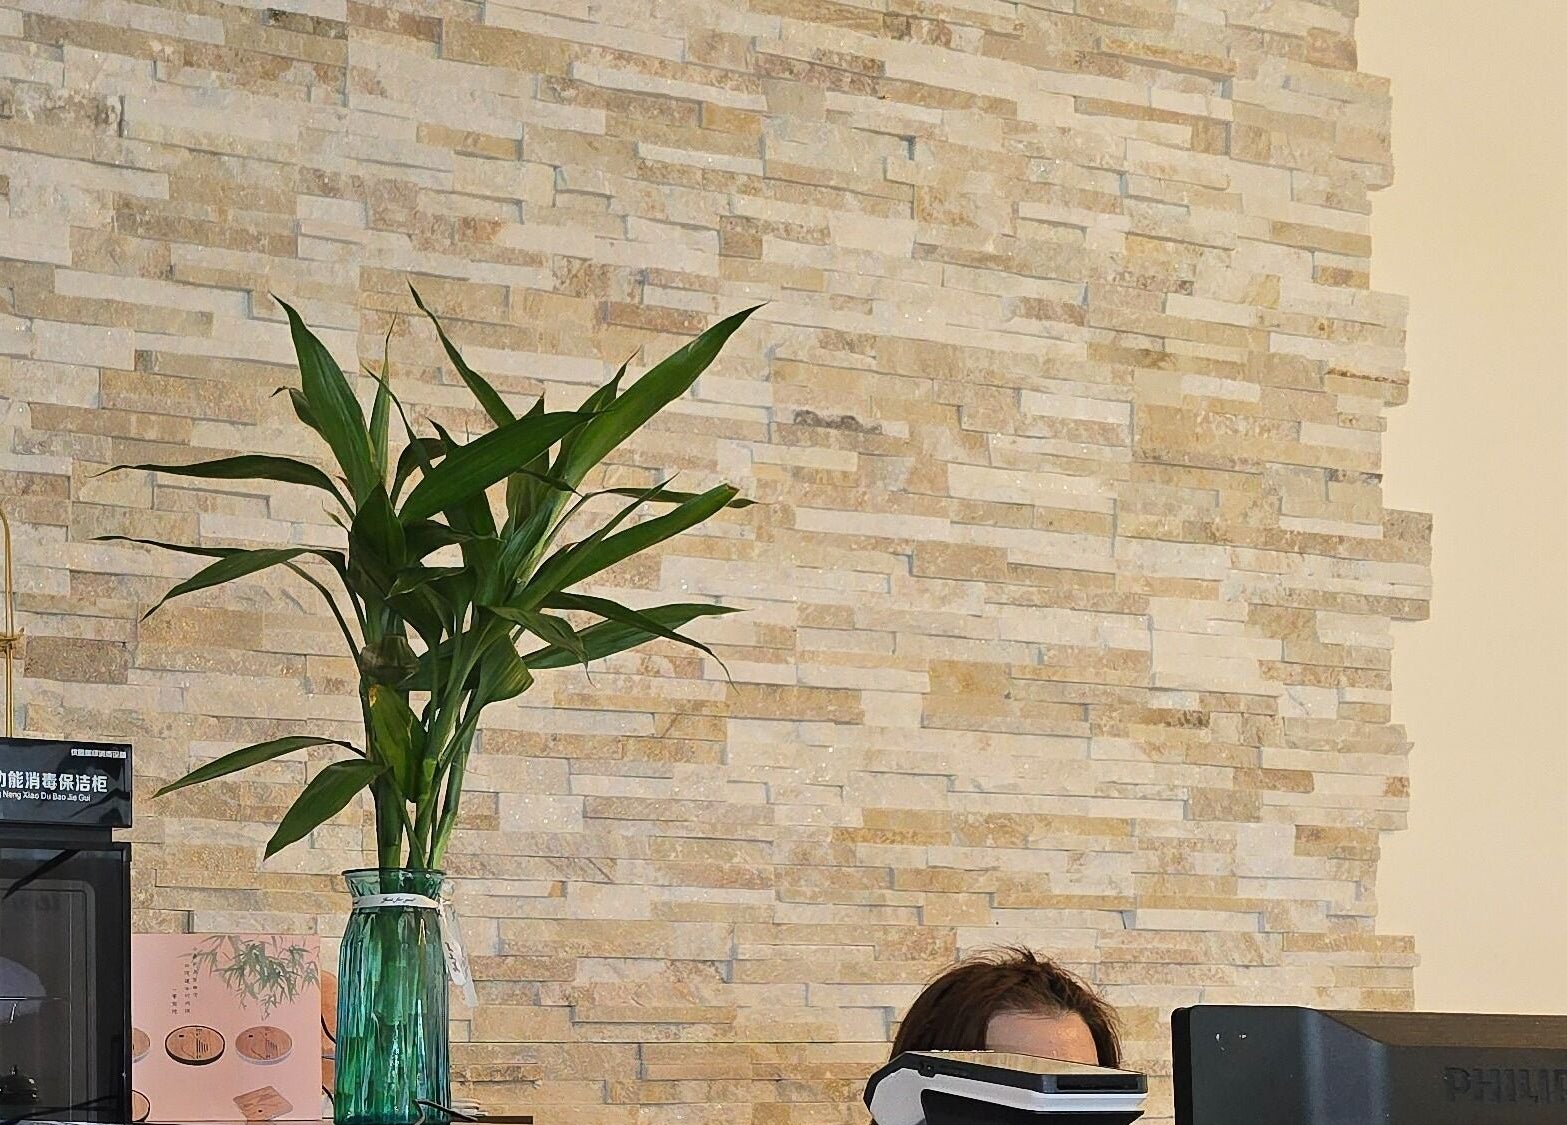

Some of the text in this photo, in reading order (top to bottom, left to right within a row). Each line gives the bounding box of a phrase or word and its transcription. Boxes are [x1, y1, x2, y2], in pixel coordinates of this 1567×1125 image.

[2, 790, 22, 800] Neng
[22, 791, 40, 799] Xiao
[40, 791, 52, 800] Du
[52, 792, 67, 801] Bao
[78, 794, 91, 802] Gui
